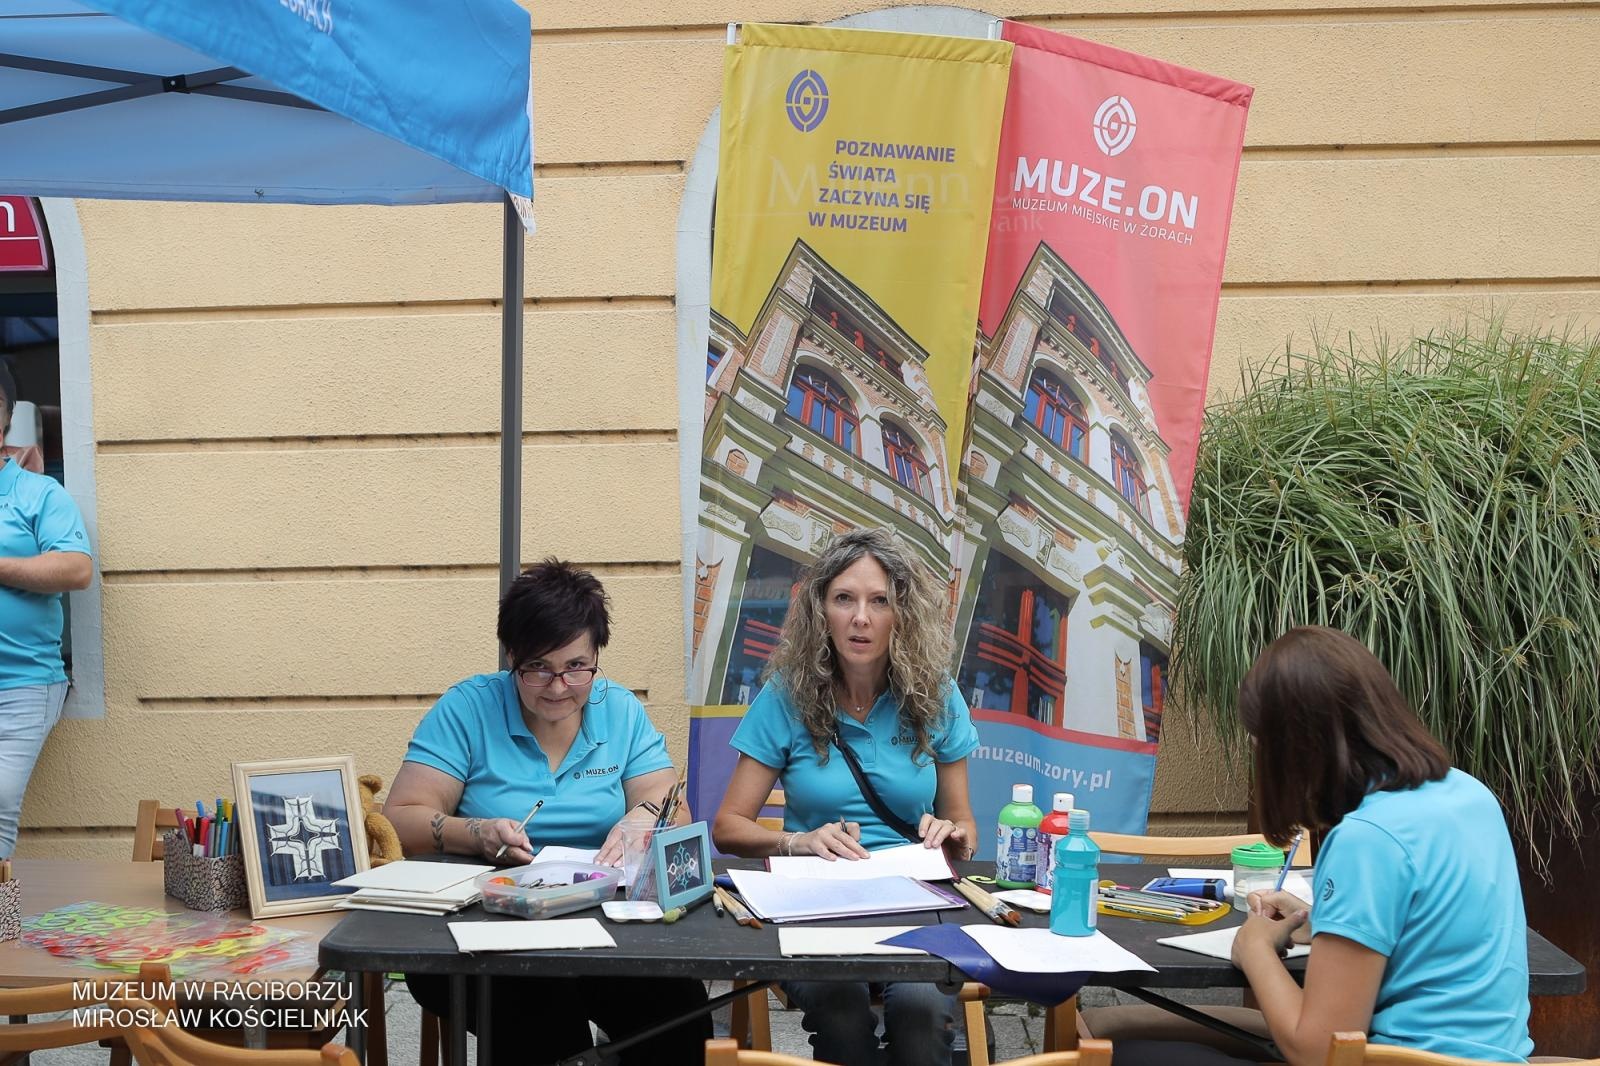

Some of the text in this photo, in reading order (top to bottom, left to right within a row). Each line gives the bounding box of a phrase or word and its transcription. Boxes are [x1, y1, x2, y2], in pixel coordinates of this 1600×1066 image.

[835, 139, 956, 163] POZNAWANIE
[828, 160, 896, 183] ŚWIATA
[818, 188, 931, 213] ZACZYNA SIĘ
[1013, 156, 1199, 229] MUZE.ON
[808, 211, 907, 232] W MUZEUM
[1012, 197, 1193, 245] MUZEUM MIEJSKIE W ŻORACH
[586, 764, 619, 775] MUZE.ON
